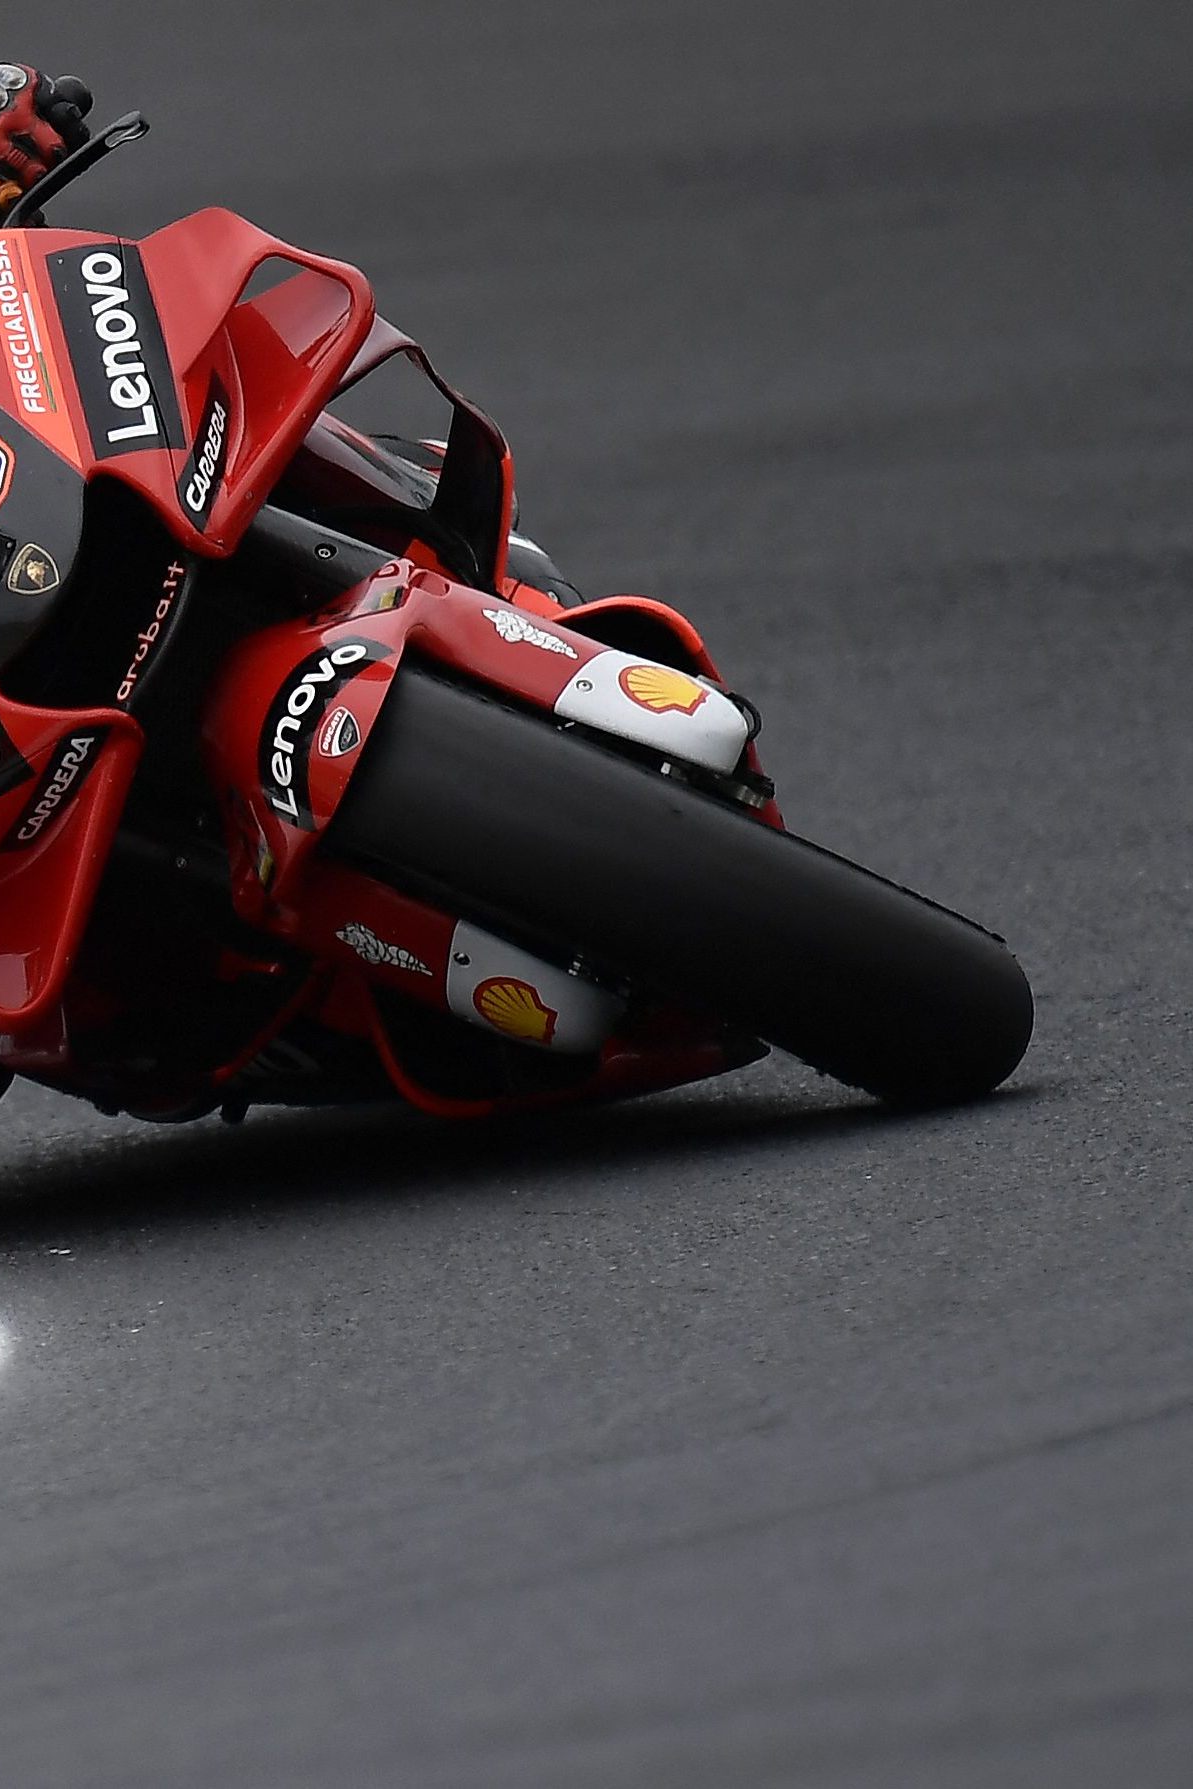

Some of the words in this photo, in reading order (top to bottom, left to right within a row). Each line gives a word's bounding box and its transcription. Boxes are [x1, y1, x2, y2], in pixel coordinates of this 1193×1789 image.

[81, 251, 159, 443] Lenovo
[186, 401, 228, 513] CARRERA
[271, 643, 367, 817] Lenovo
[322, 711, 343, 751] DUCATI
[17, 736, 95, 841] CARRERA
